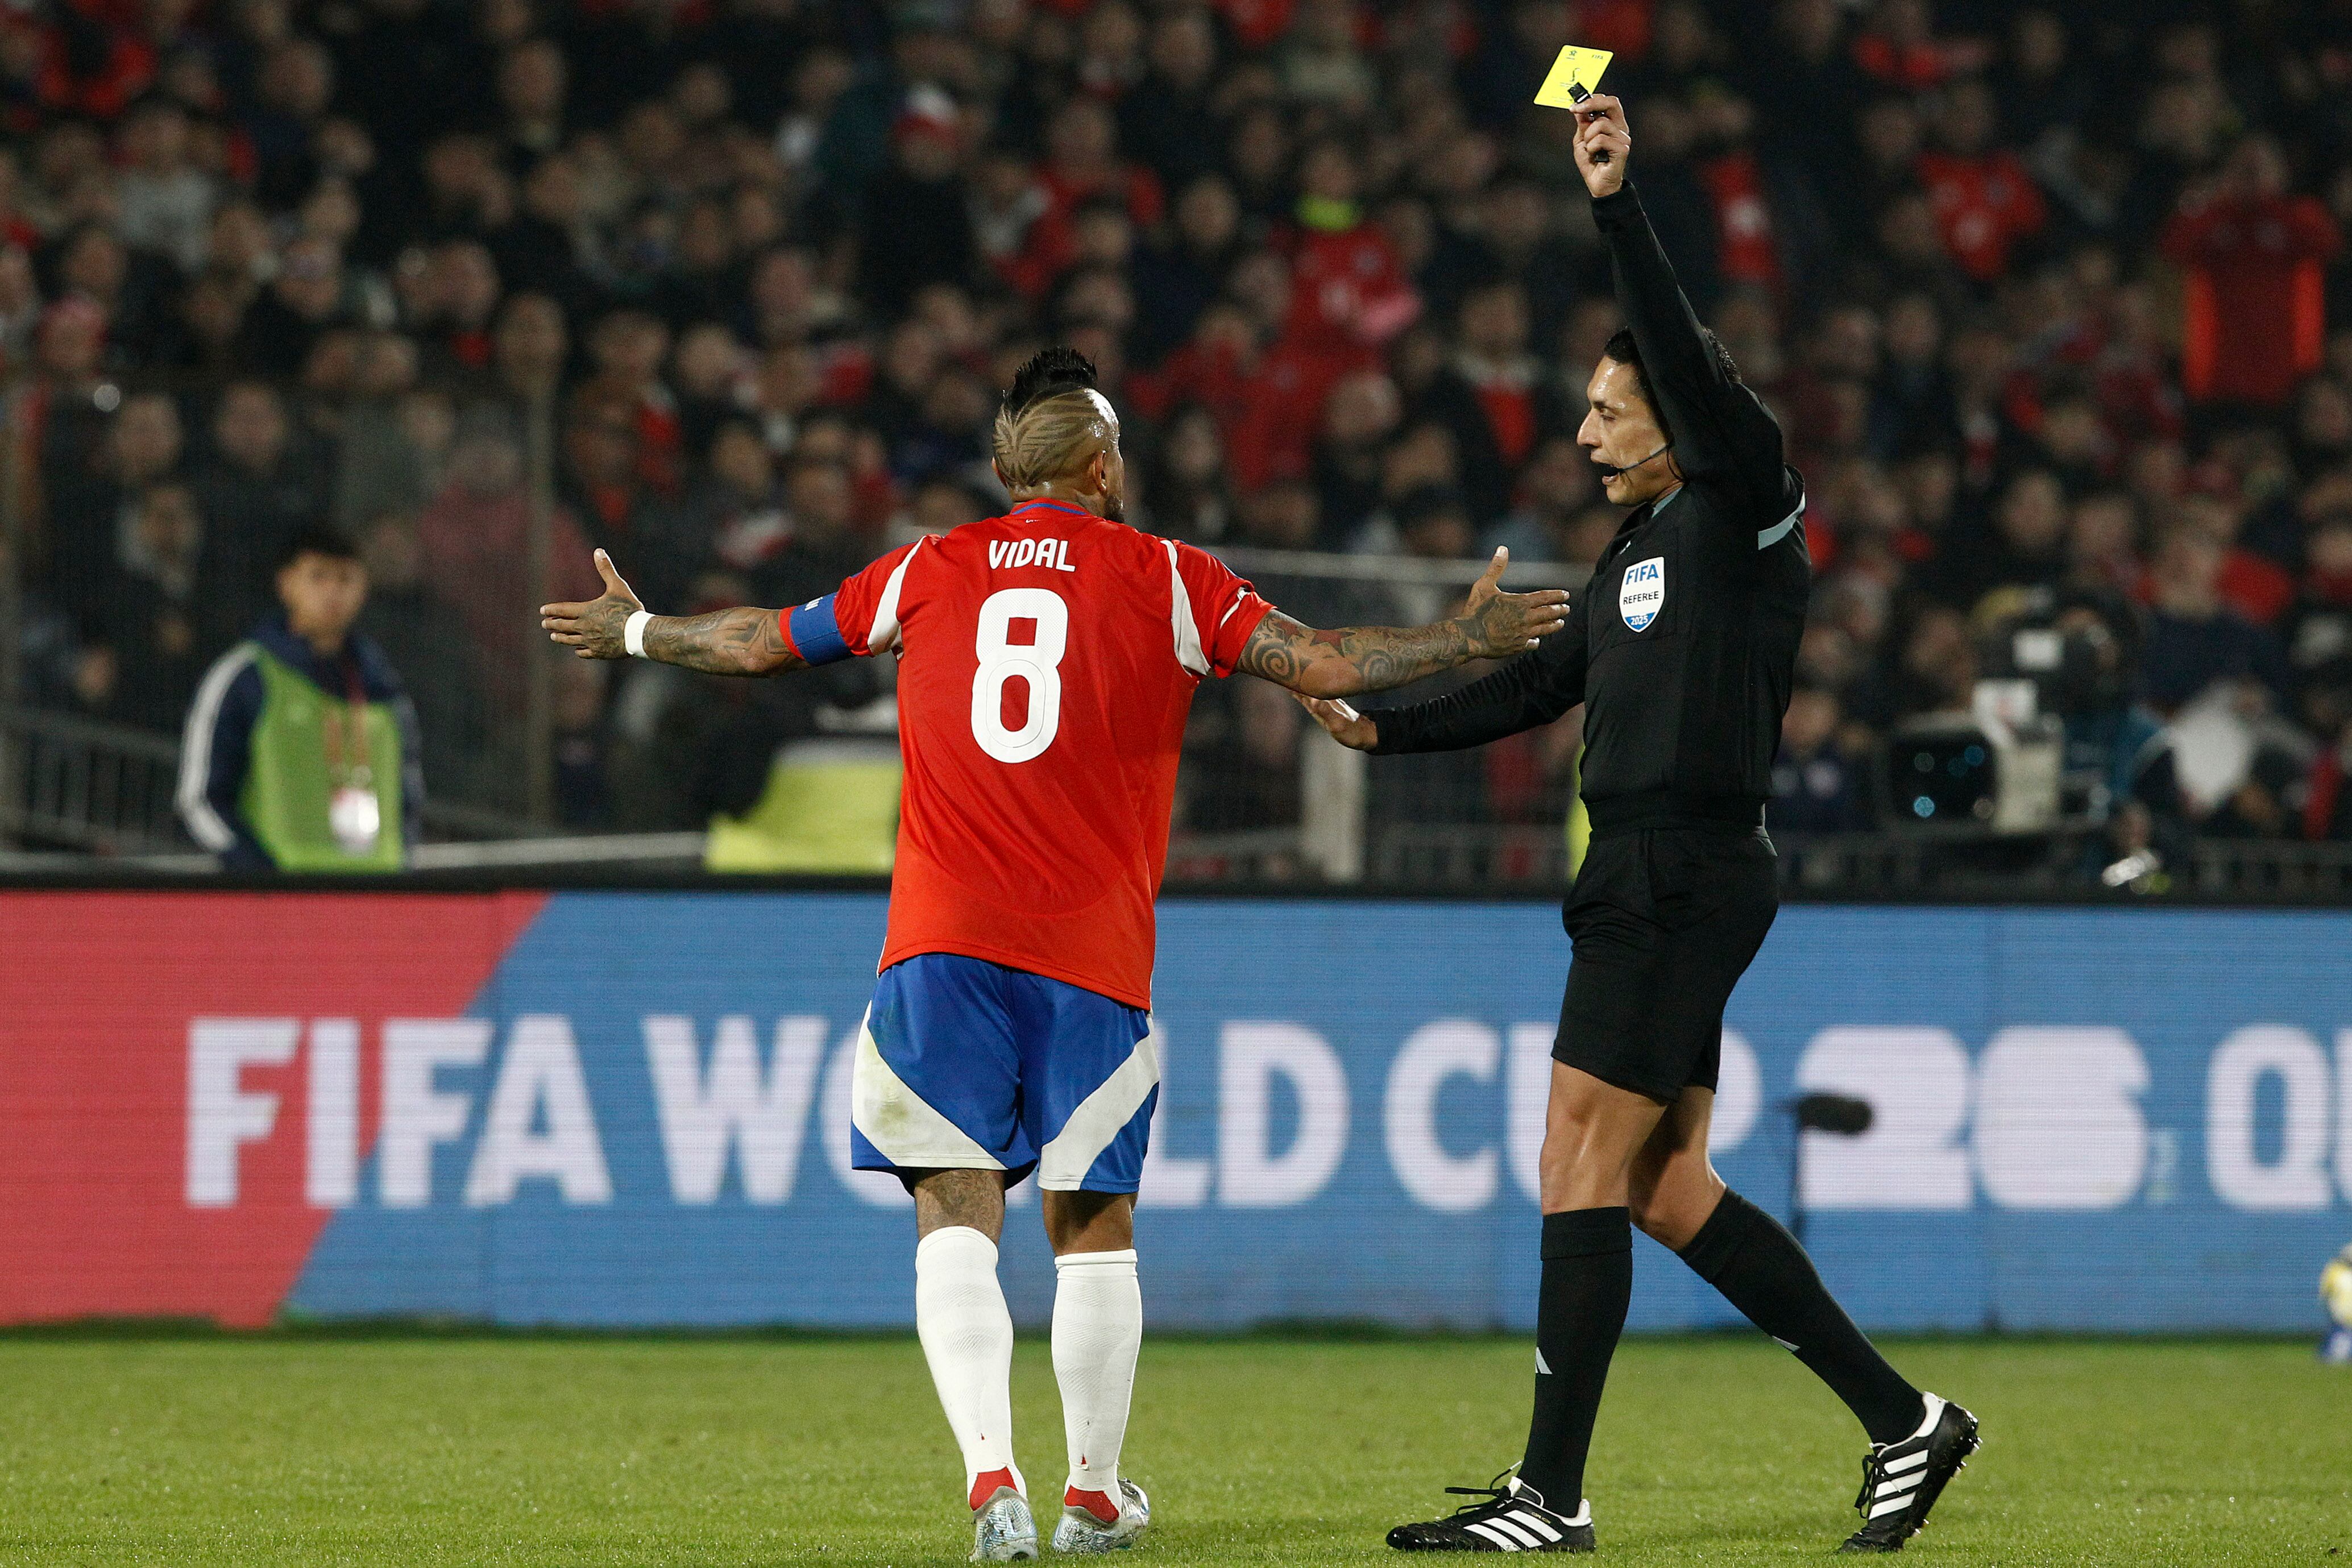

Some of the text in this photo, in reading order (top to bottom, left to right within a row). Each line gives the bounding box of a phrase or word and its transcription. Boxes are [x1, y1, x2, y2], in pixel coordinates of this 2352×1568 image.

[989, 538, 1076, 572] VIDAL
[1625, 563, 1659, 585] FIFA
[1623, 591, 1659, 605] REFEREE
[1630, 615, 1649, 625] 2025
[970, 587, 1069, 764] 8
[185, 1014, 613, 1209] FIFA
[644, 1015, 1350, 1208] WLD
[1794, 1025, 2151, 1210] 26
[2206, 1024, 2352, 1210] Q
